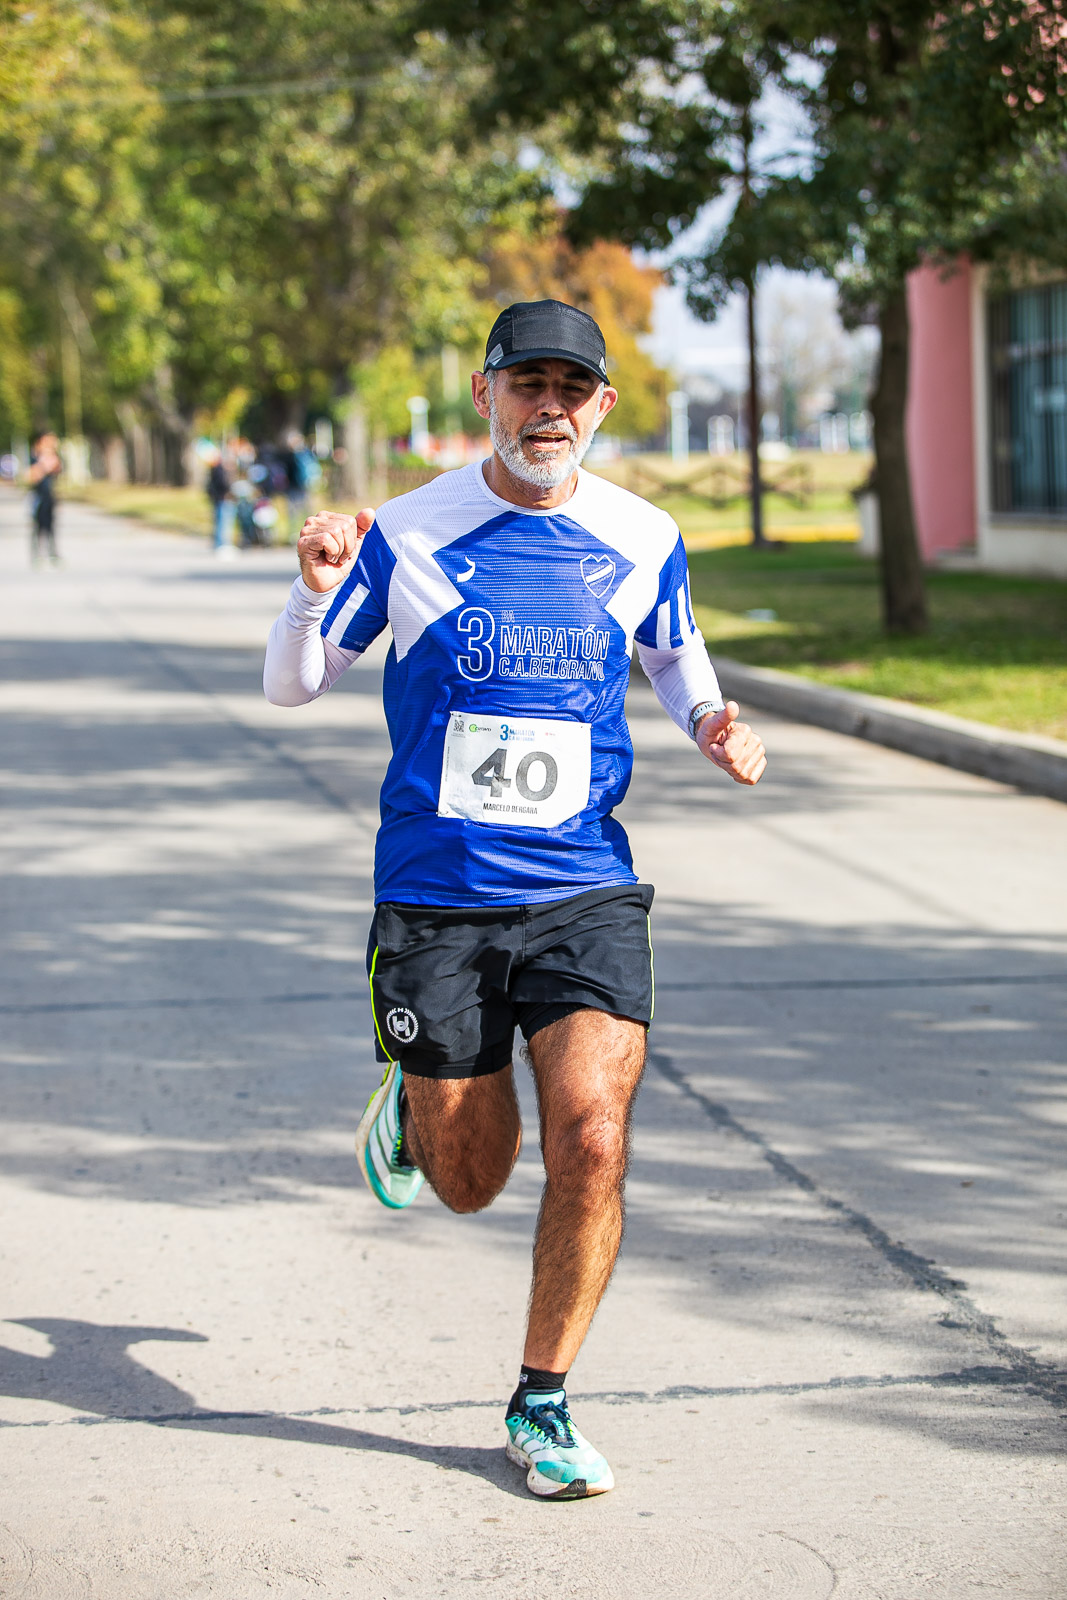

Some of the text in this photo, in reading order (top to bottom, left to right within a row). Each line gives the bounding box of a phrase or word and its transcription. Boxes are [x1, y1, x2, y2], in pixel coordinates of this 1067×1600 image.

[457, 606, 495, 682] 3
[500, 624, 610, 661] MARATÓN
[499, 723, 509, 741] 3
[471, 747, 558, 802] 40
[483, 802, 538, 815] MARCELO BERGARA
